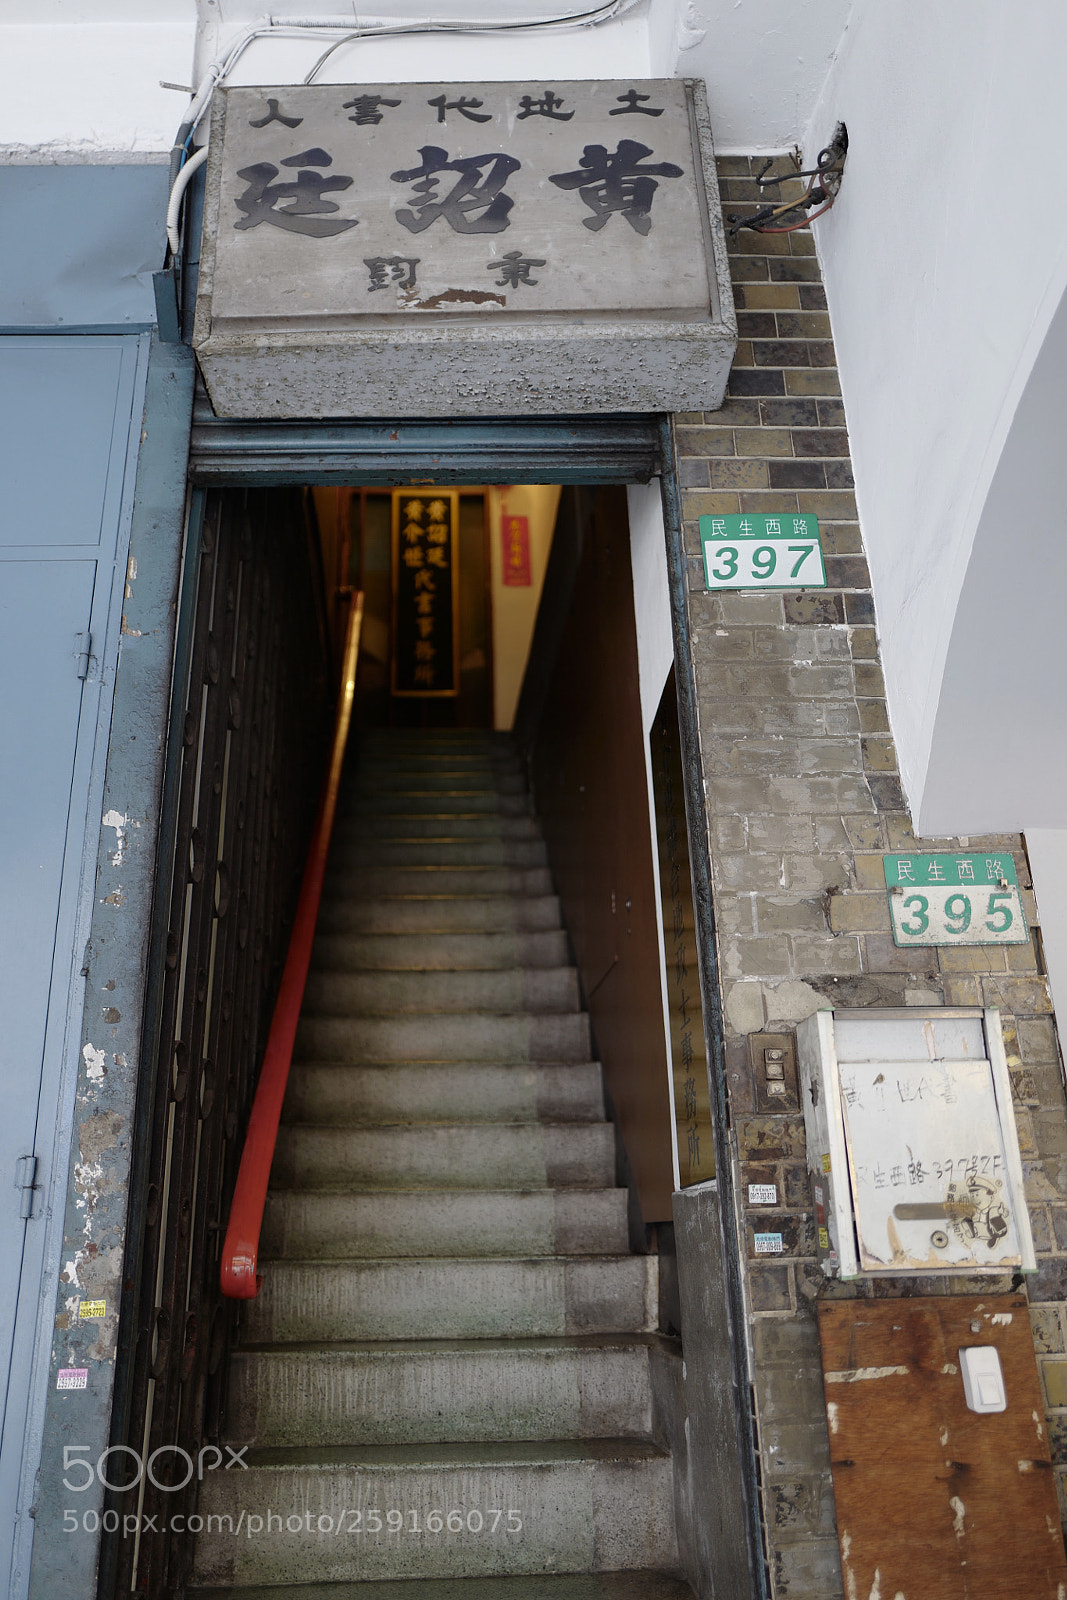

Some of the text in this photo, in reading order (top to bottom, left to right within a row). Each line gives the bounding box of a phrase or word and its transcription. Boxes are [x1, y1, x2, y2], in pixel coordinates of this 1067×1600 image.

[249, 89, 665, 130] 土地代書人
[711, 518, 808, 537] 民生西路
[712, 546, 814, 580] 397
[897, 859, 1004, 881] 民生西路
[901, 893, 1014, 936] 395
